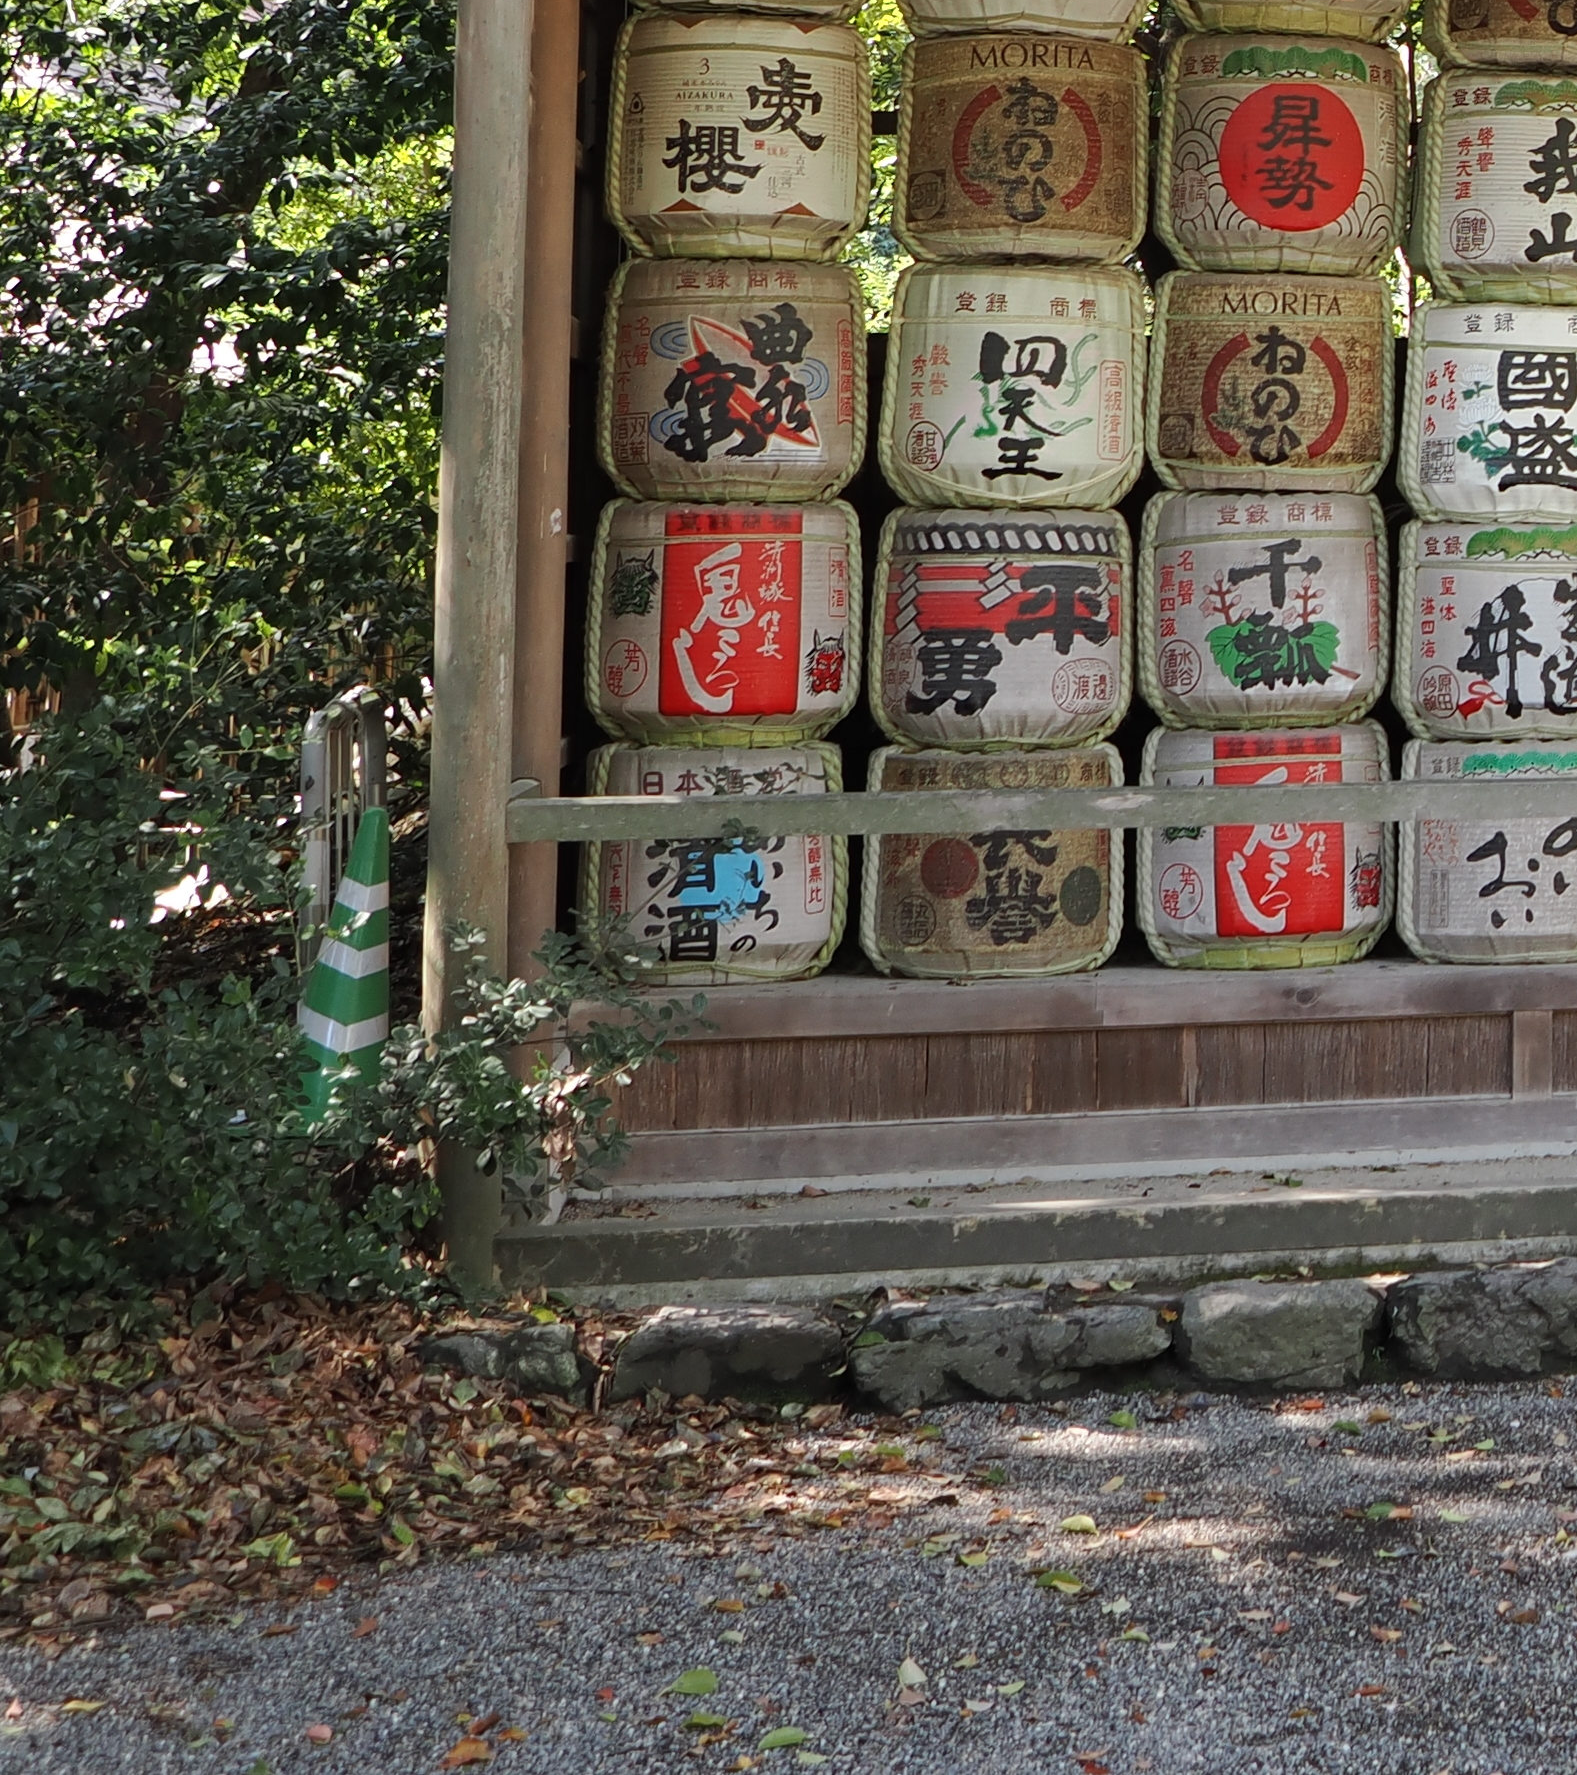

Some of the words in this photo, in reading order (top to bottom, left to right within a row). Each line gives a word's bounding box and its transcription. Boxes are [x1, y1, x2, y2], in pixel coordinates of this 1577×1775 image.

[700, 58, 710, 75] 3
[970, 43, 1095, 70] MORITA
[675, 92, 734, 100] AIZAKURA
[1001, 77, 1059, 222] ねのひ
[955, 292, 1009, 314] 登録
[1221, 291, 1342, 315] MORITA
[1463, 314, 1515, 334] 登録
[980, 331, 1066, 480] 四天王
[1246, 326, 1306, 464] ねのひ
[1218, 505, 1268, 524] 登録
[1287, 502, 1334, 522] 商標
[1424, 537, 1462, 555] 登録
[672, 542, 756, 712] 鬼ころし
[608, 644, 642, 695] 芳醇
[1163, 868, 1195, 915] 芳醇
